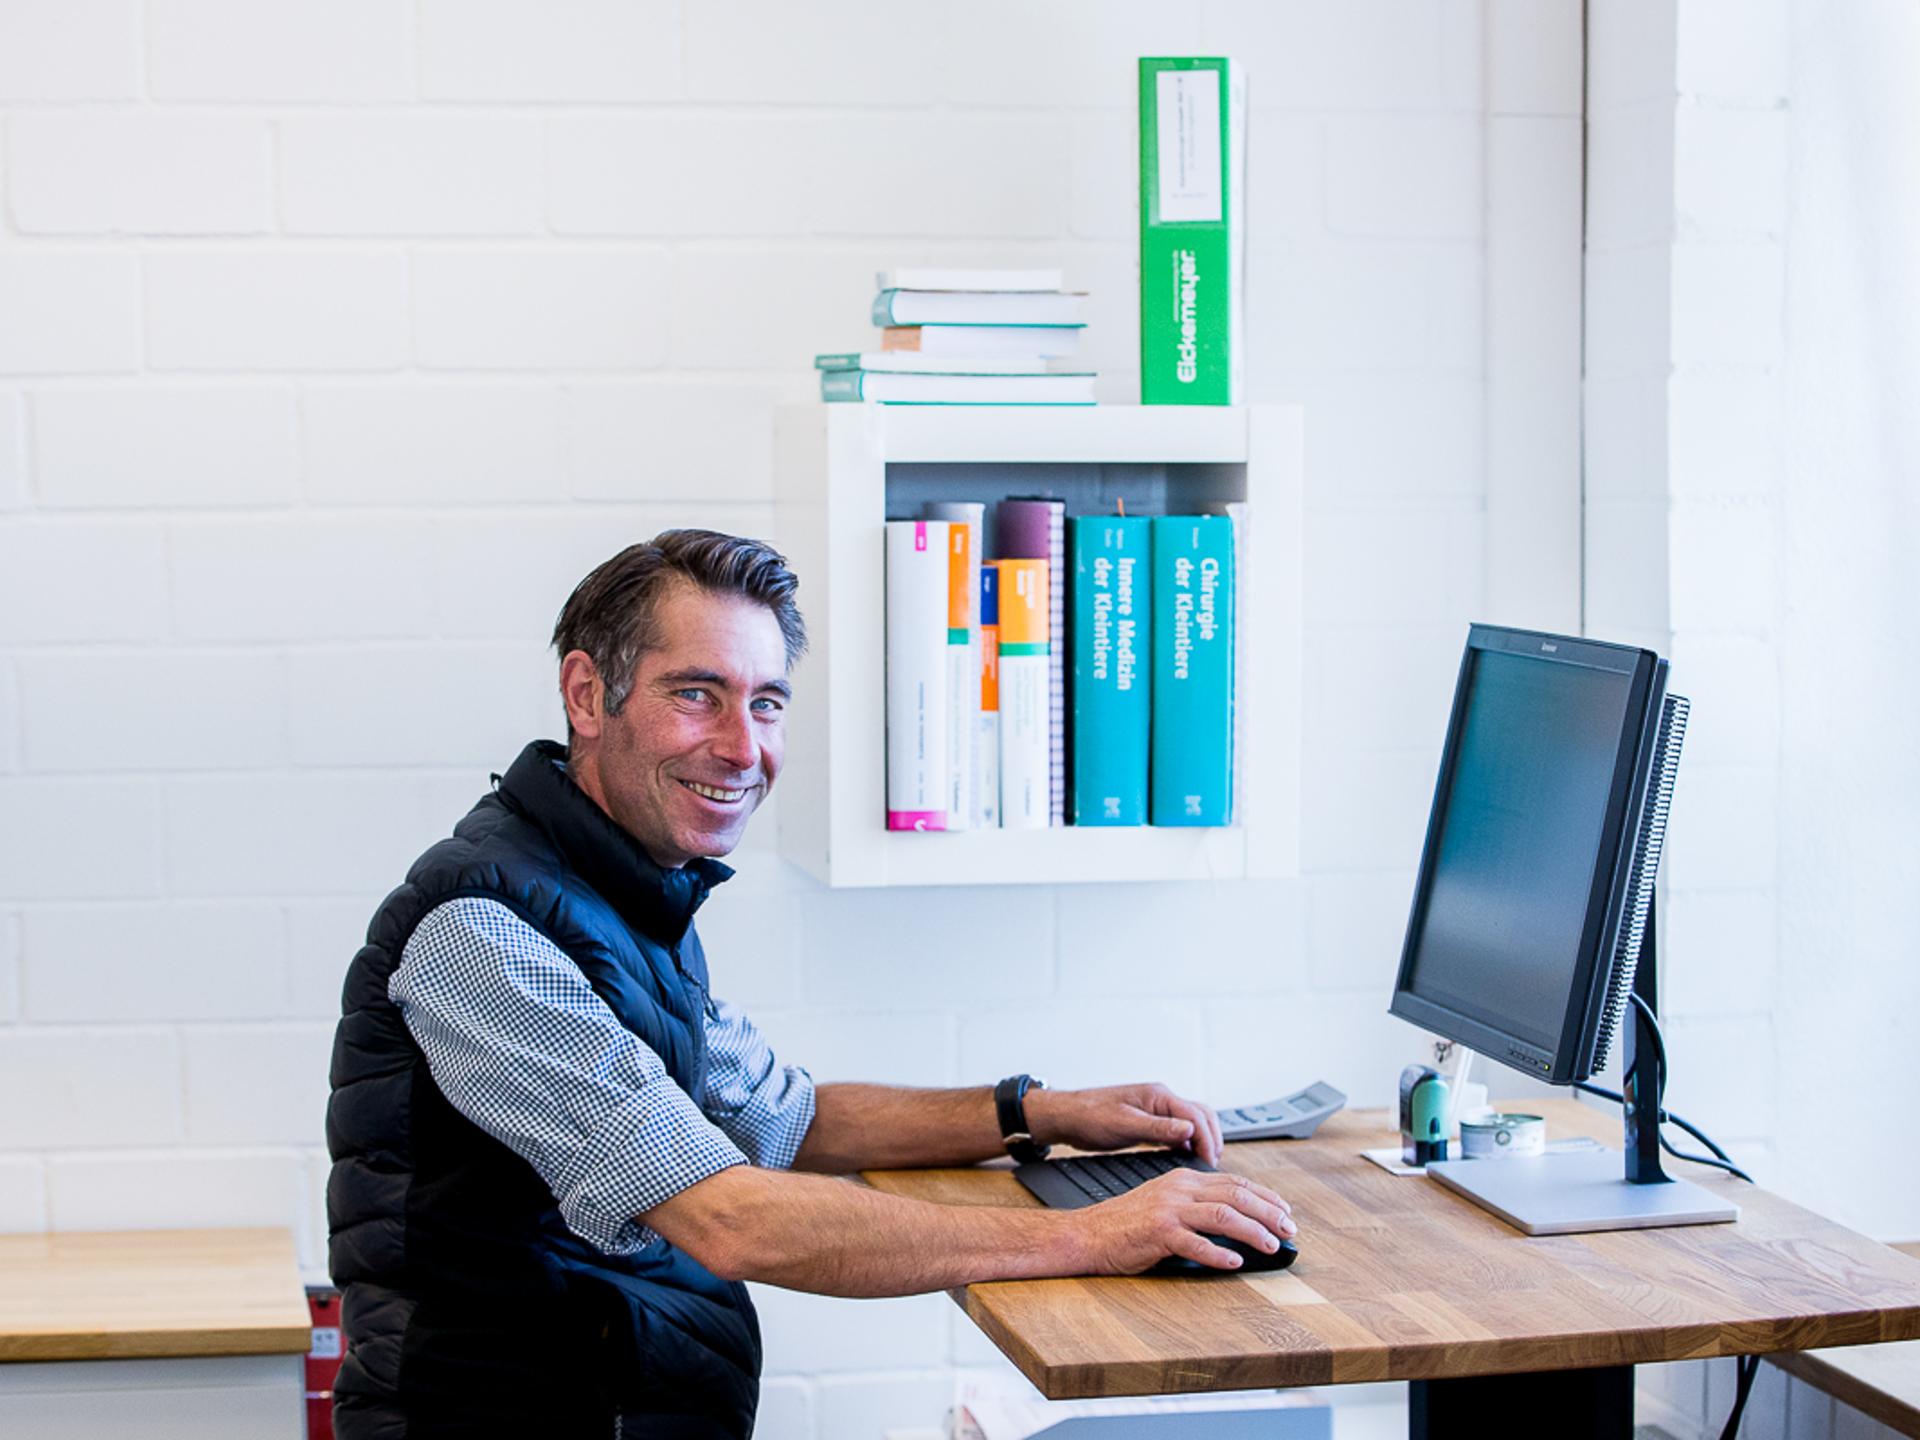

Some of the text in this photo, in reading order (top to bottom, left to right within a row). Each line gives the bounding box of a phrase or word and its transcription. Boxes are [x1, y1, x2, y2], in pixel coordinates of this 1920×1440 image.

[1094, 557, 1112, 587] der
[1196, 557, 1219, 641] Chirurgie
[1094, 593, 1112, 679] Kleintiere
[1117, 557, 1136, 691] Innere Medizin
[1175, 557, 1193, 679] der Kleintiere
